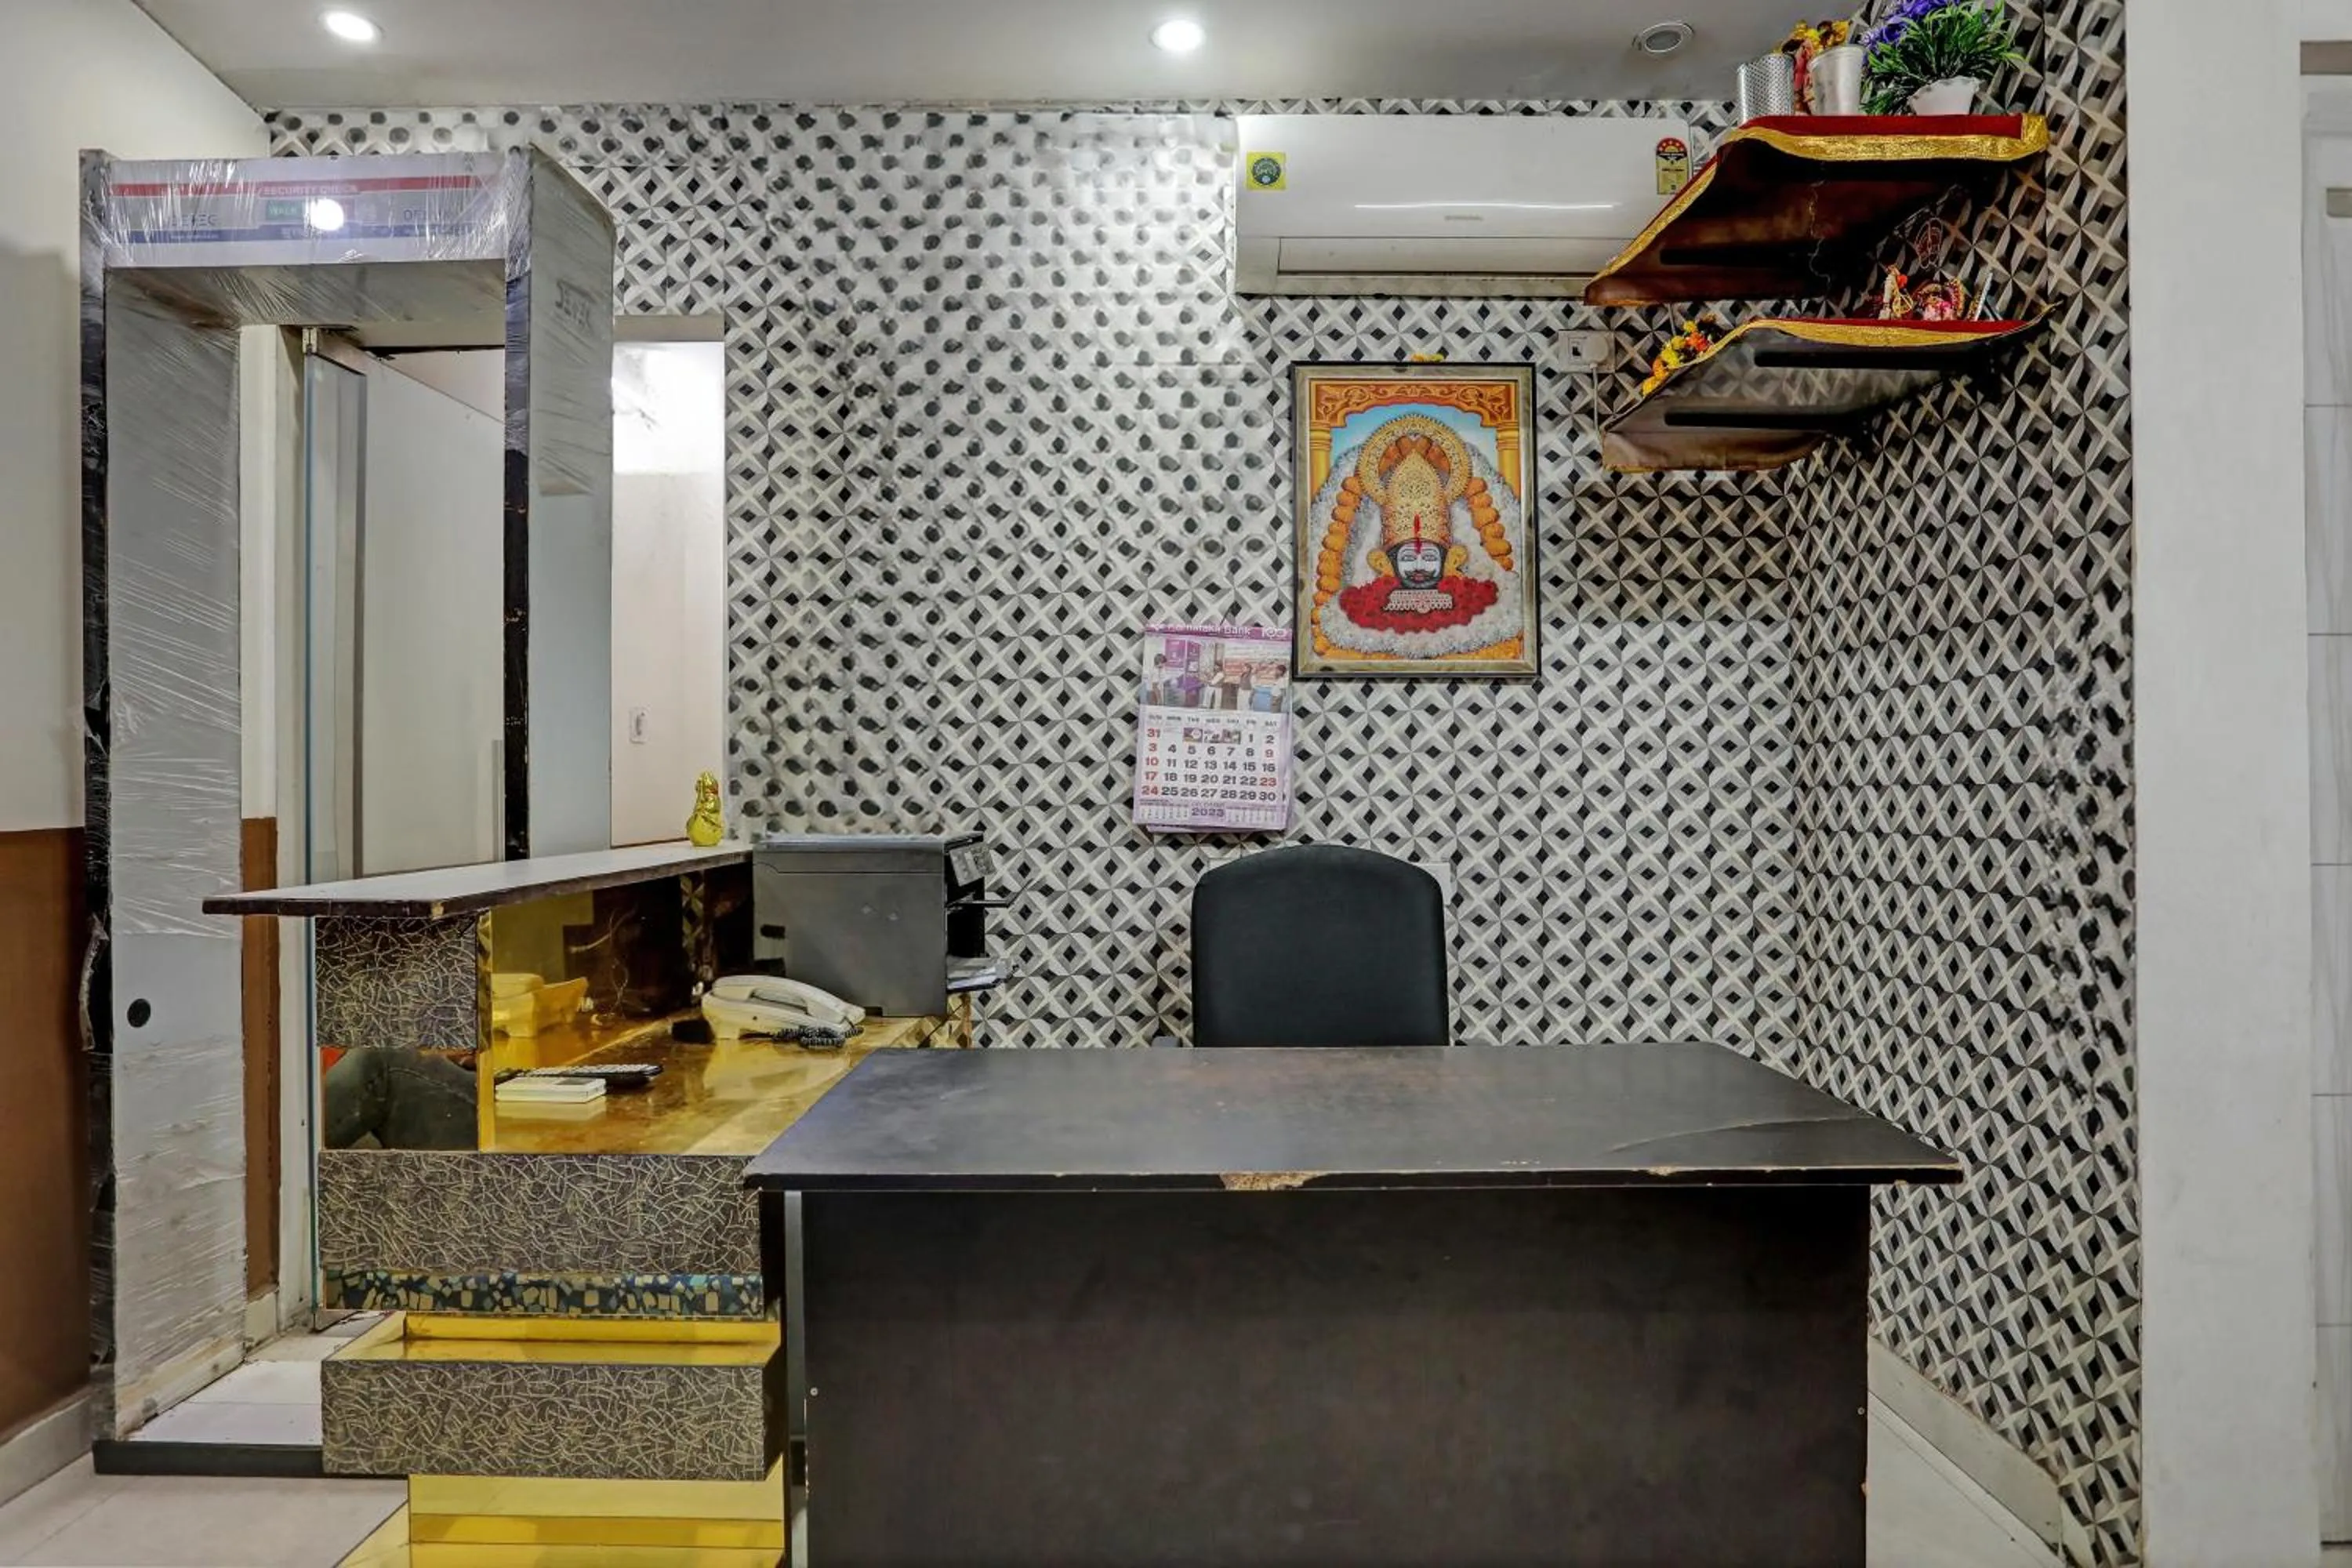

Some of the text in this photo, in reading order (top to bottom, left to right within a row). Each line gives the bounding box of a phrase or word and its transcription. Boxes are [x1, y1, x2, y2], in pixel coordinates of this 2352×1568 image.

[1224, 626, 1250, 635] Bank
[1147, 728, 1274, 744] 31 1 2
[1149, 743, 1274, 758] 3 4 5 6 7 8 9
[1145, 757, 1276, 772] 10 11 12 13 14 15 16
[1145, 771, 1276, 787] 17 18 19 20 21 22 23
[1141, 786, 1276, 801] 24 25 26 27 28 29 30
[1191, 808, 1225, 818] 2023
